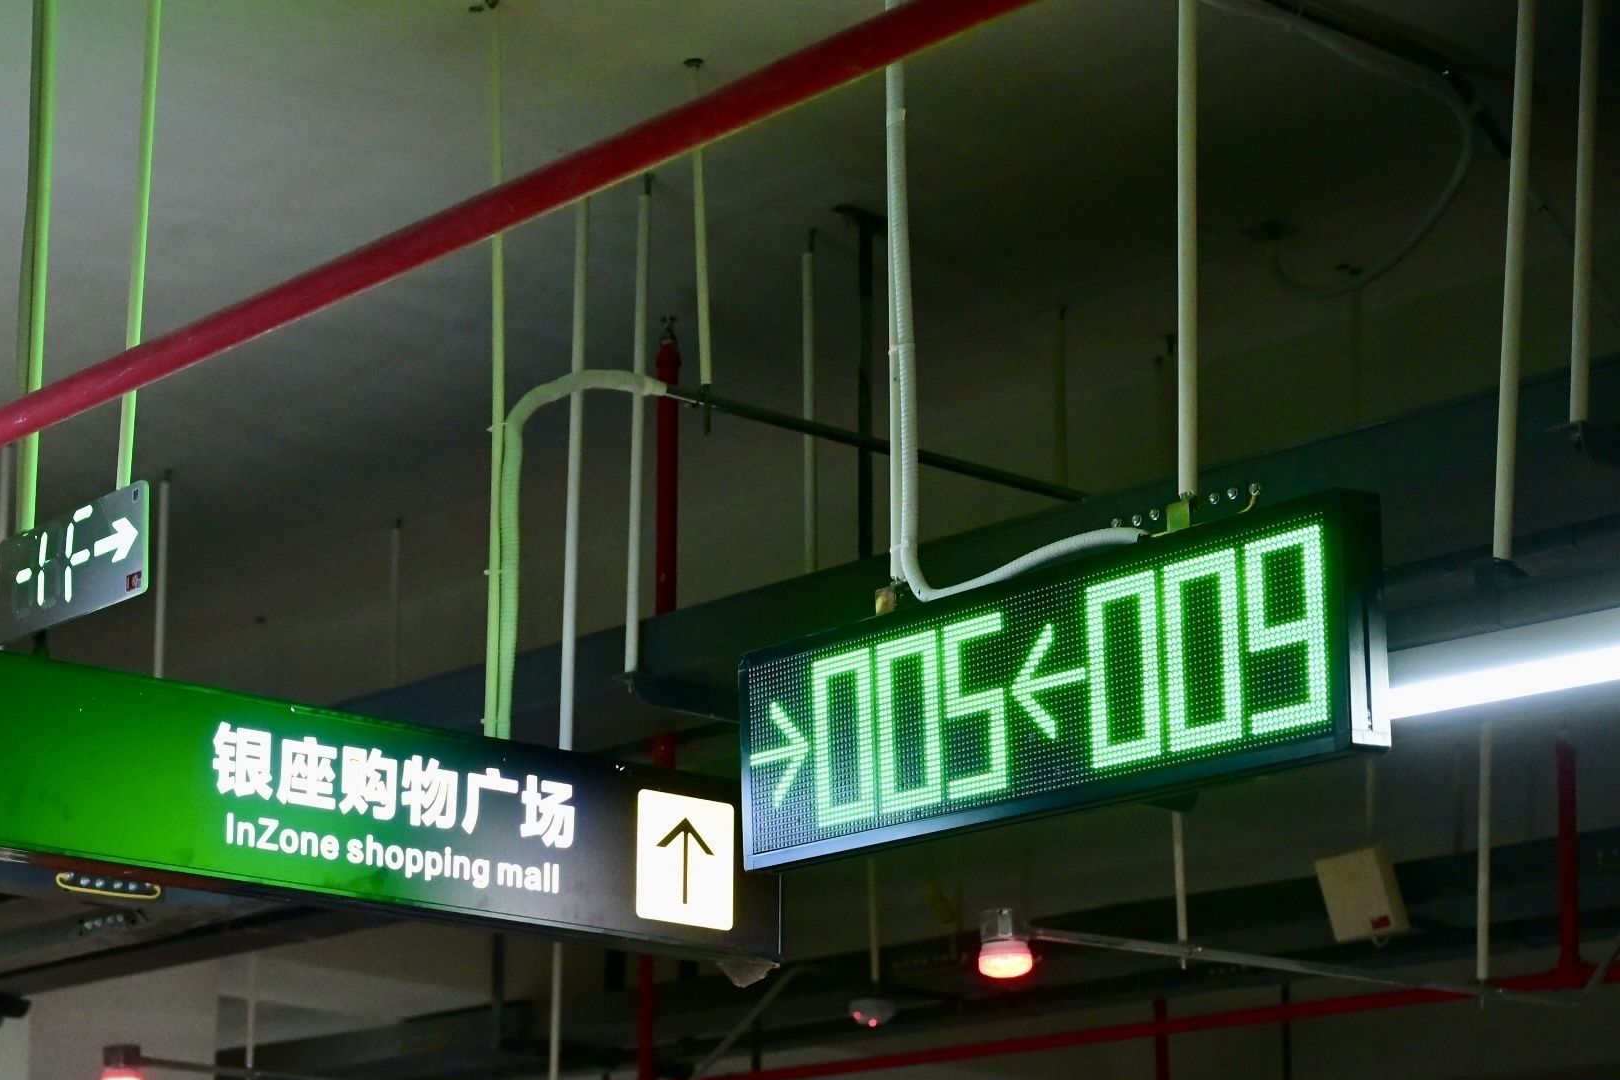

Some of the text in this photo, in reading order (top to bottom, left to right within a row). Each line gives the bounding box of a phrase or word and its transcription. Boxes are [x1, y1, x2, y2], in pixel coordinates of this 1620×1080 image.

[810, 523, 1330, 829] 005 009
[212, 721, 576, 849] 银座购物广场
[226, 812, 560, 895] InZone shopping mall
